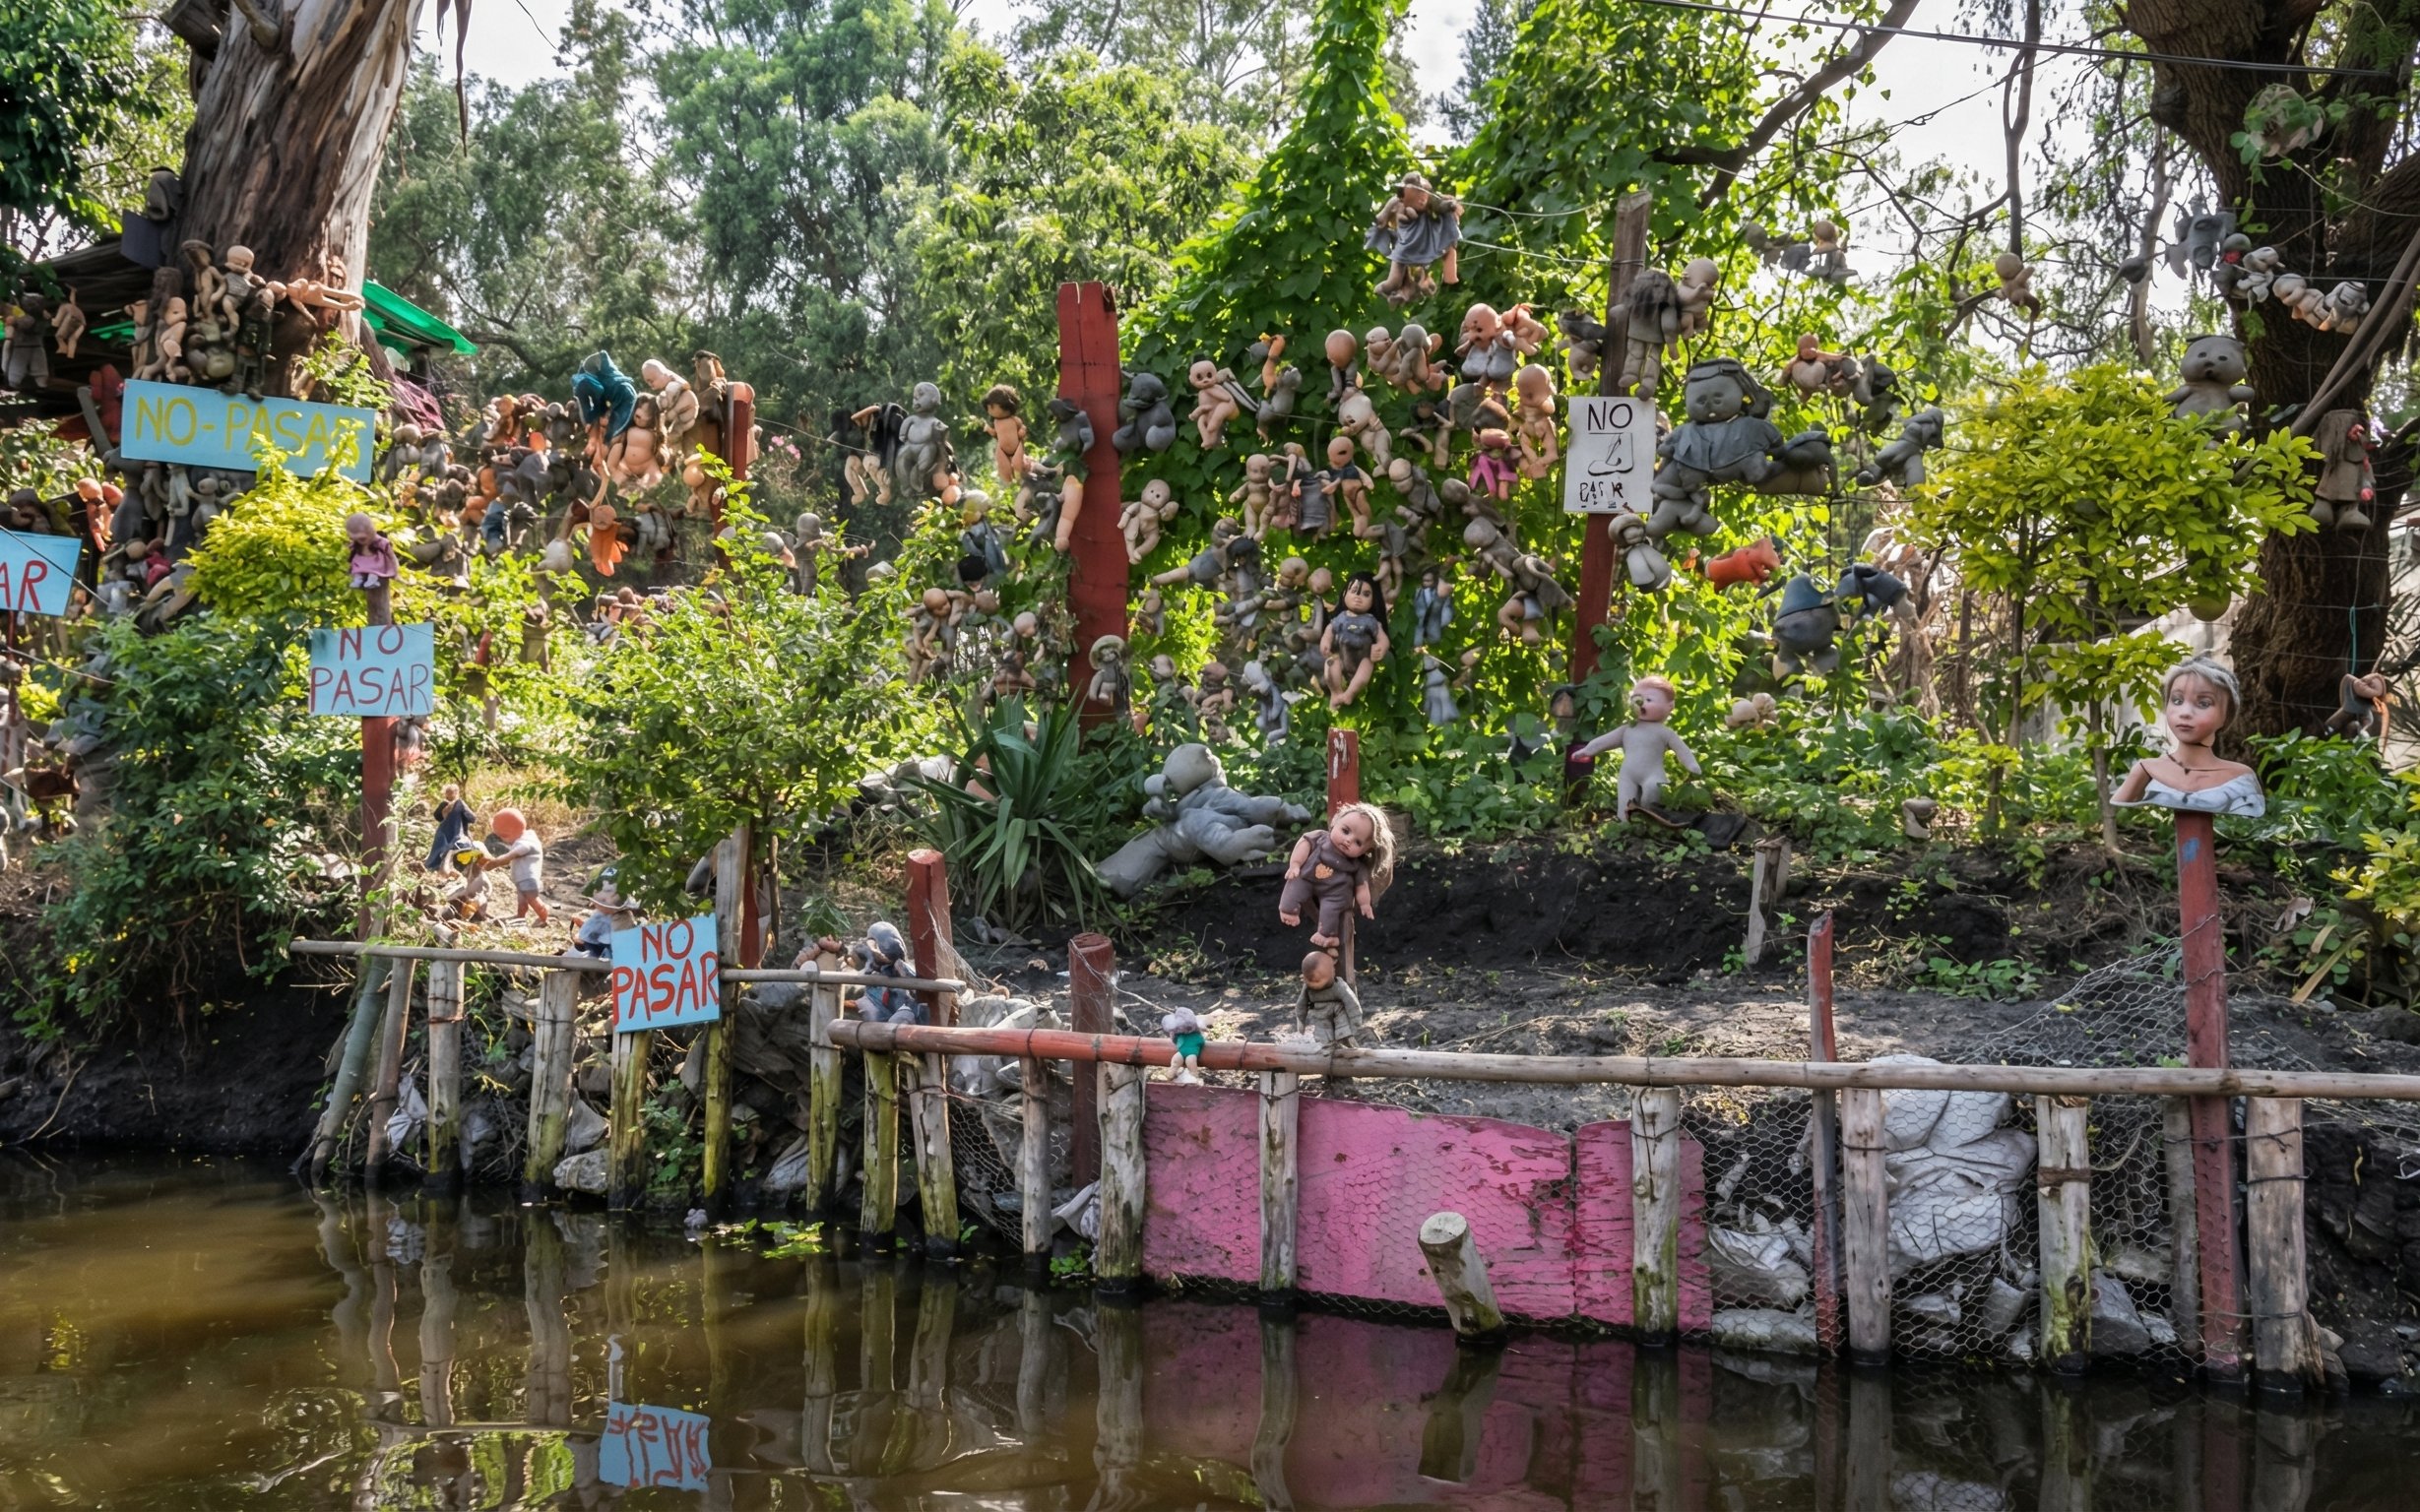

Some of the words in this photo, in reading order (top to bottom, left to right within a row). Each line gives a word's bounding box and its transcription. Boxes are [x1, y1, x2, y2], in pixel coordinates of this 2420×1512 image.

[1587, 401, 1633, 431] NO
[339, 624, 404, 662] NO
[309, 663, 430, 715] PASAR
[641, 918, 694, 964] NO
[611, 951, 720, 1026] PASAR
